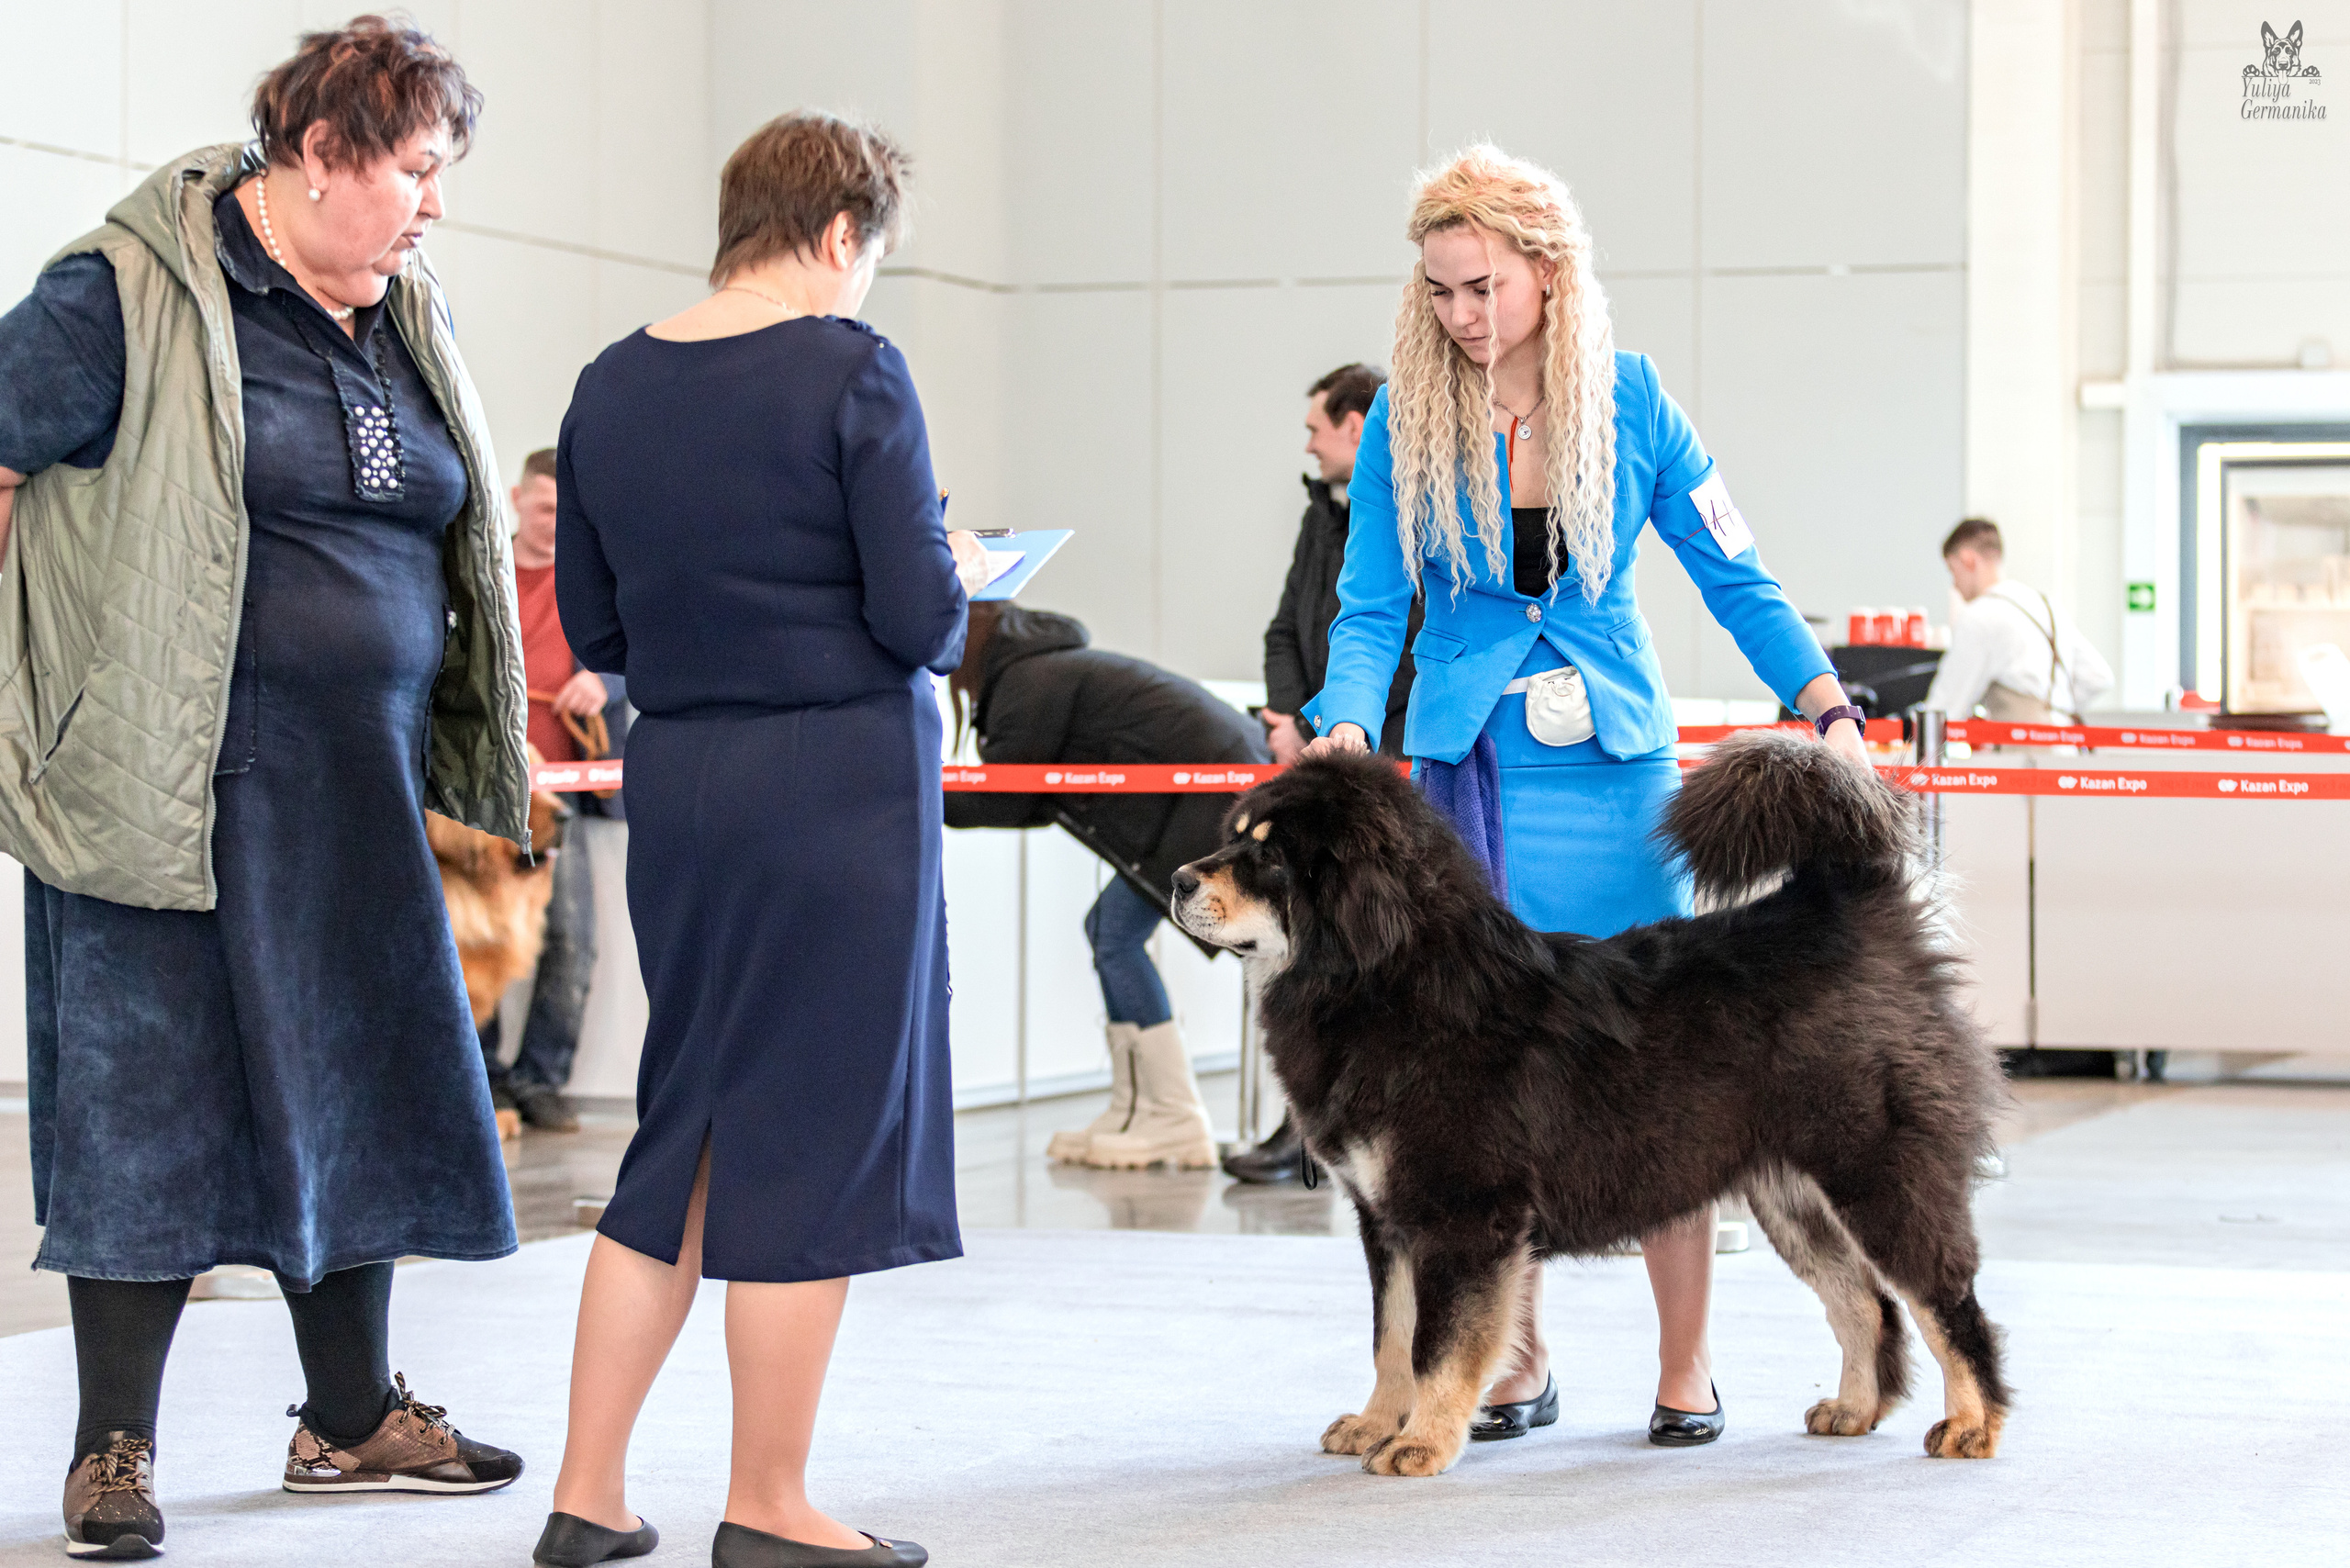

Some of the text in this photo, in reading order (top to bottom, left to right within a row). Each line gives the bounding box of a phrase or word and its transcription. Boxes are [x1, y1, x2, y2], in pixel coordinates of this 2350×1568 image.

[959, 770, 987, 785] Expo
[1064, 770, 1125, 786] Kazan Expo
[1192, 770, 1255, 786] Kazan Expo
[1931, 774, 1967, 787] Kazan
[1968, 773, 1998, 789] Expo
[2080, 776, 2147, 793] Kazan Expo
[2240, 778, 2309, 796] Kazan Expo
